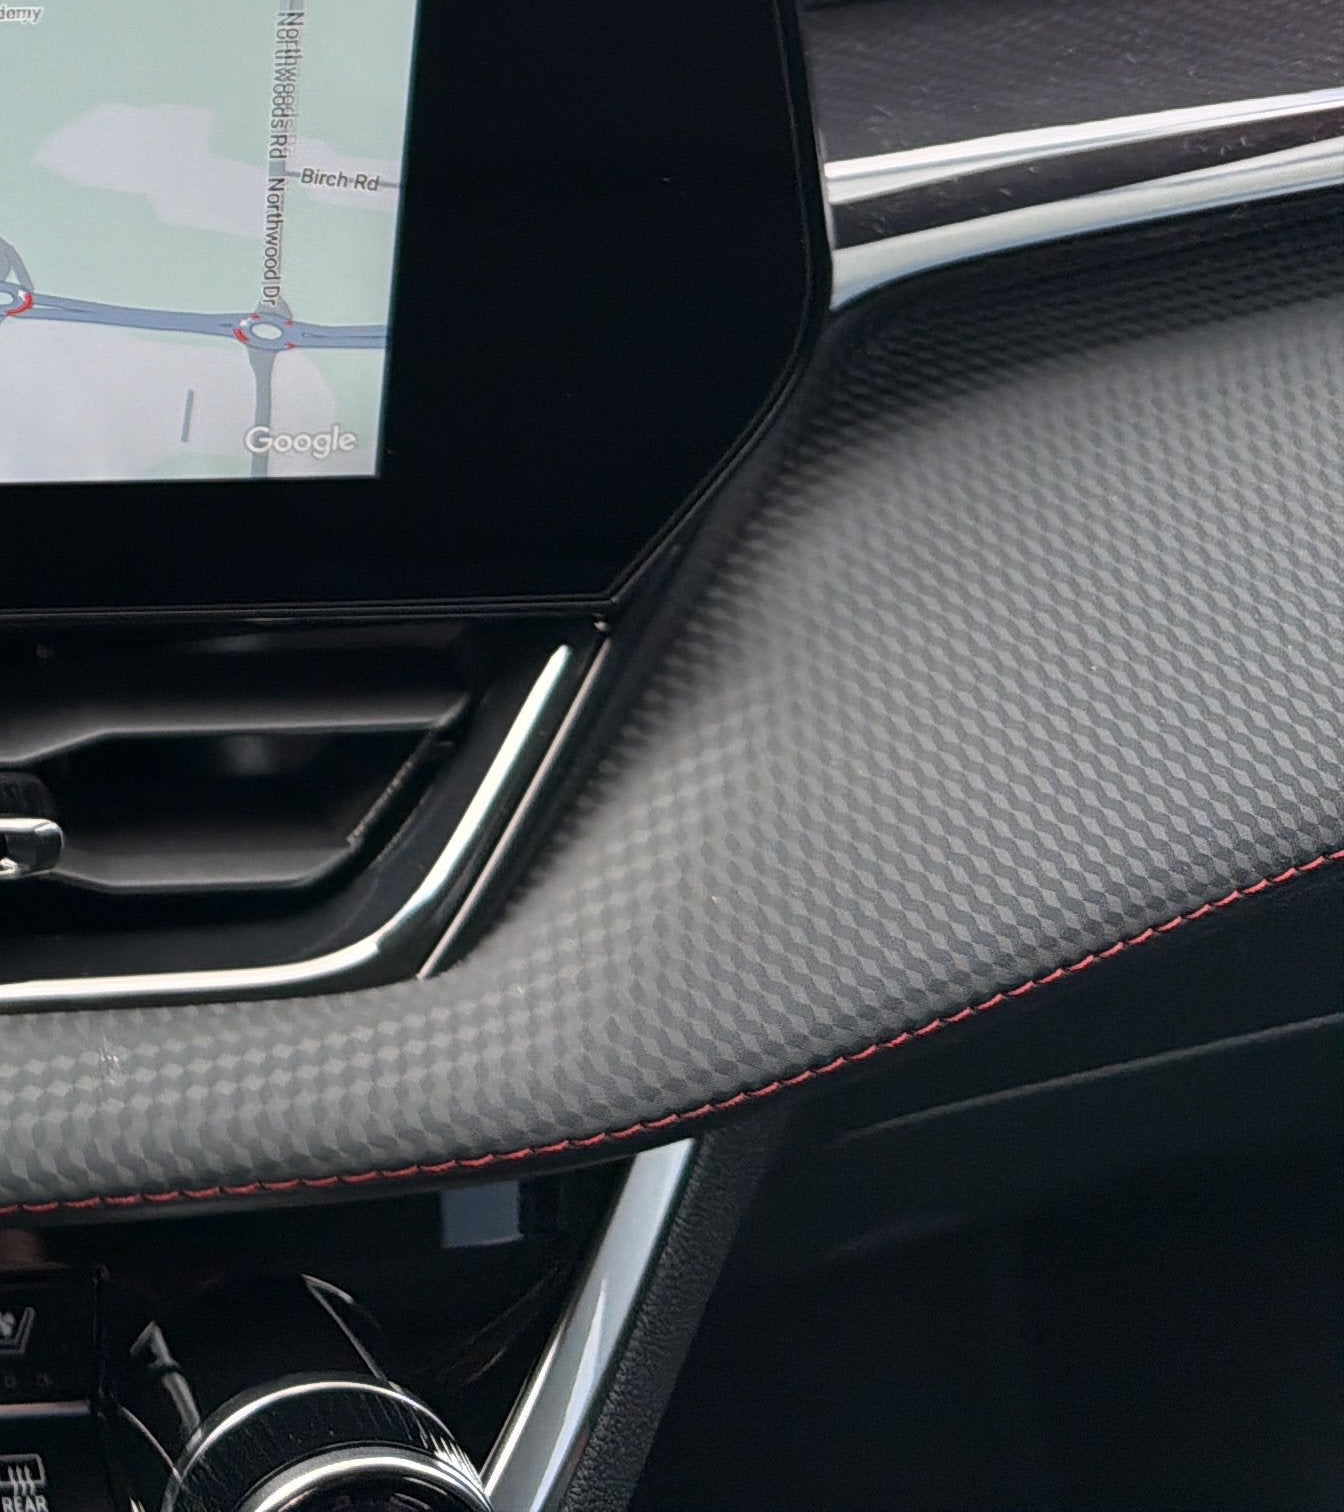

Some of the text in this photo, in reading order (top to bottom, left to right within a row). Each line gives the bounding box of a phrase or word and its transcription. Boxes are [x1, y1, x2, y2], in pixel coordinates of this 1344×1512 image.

[269, 12, 300, 159] Northwoods Rd
[301, 168, 379, 191] Birch Rd
[263, 178, 284, 306] Northwood Dr
[245, 426, 357, 459] Google
